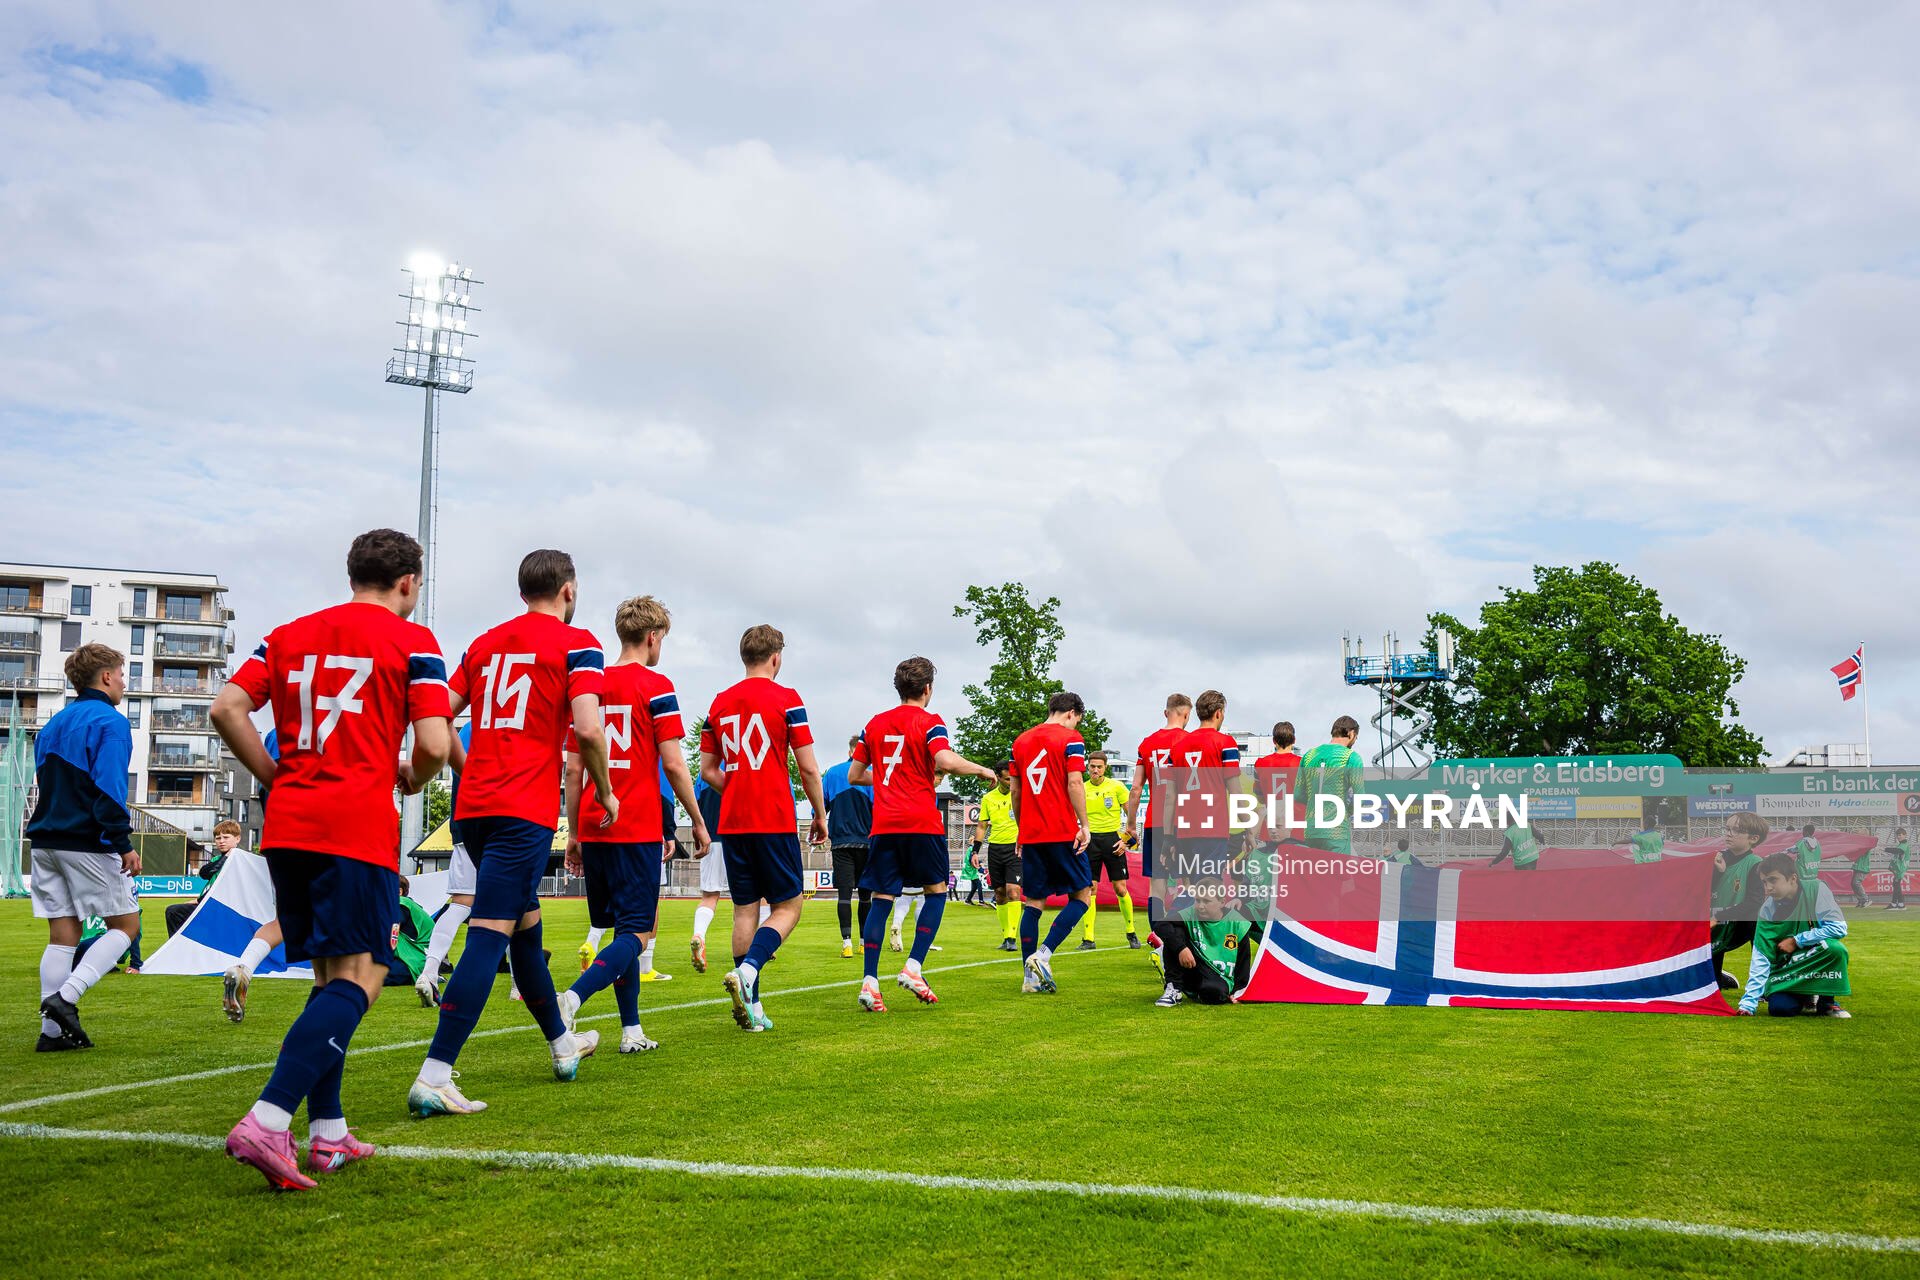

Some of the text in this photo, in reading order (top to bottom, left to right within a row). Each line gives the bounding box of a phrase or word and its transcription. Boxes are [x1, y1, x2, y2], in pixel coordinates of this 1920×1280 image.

[287, 654, 374, 755] 17
[480, 653, 537, 730] 15
[719, 713, 771, 772] 20
[882, 735, 905, 787] 7
[1026, 748, 1047, 795] 6
[1184, 751, 1203, 791] 8
[1442, 760, 1665, 788] Marker & Eidsberg
[1523, 787, 1580, 796] SPAREBANK
[1803, 774, 1918, 792] En bank der
[1695, 801, 1750, 810] WESTPORT
[1828, 798, 1890, 809] Hydroclean
[136, 876, 193, 894] NB DNB
[1877, 885, 1911, 893] HOTLS
